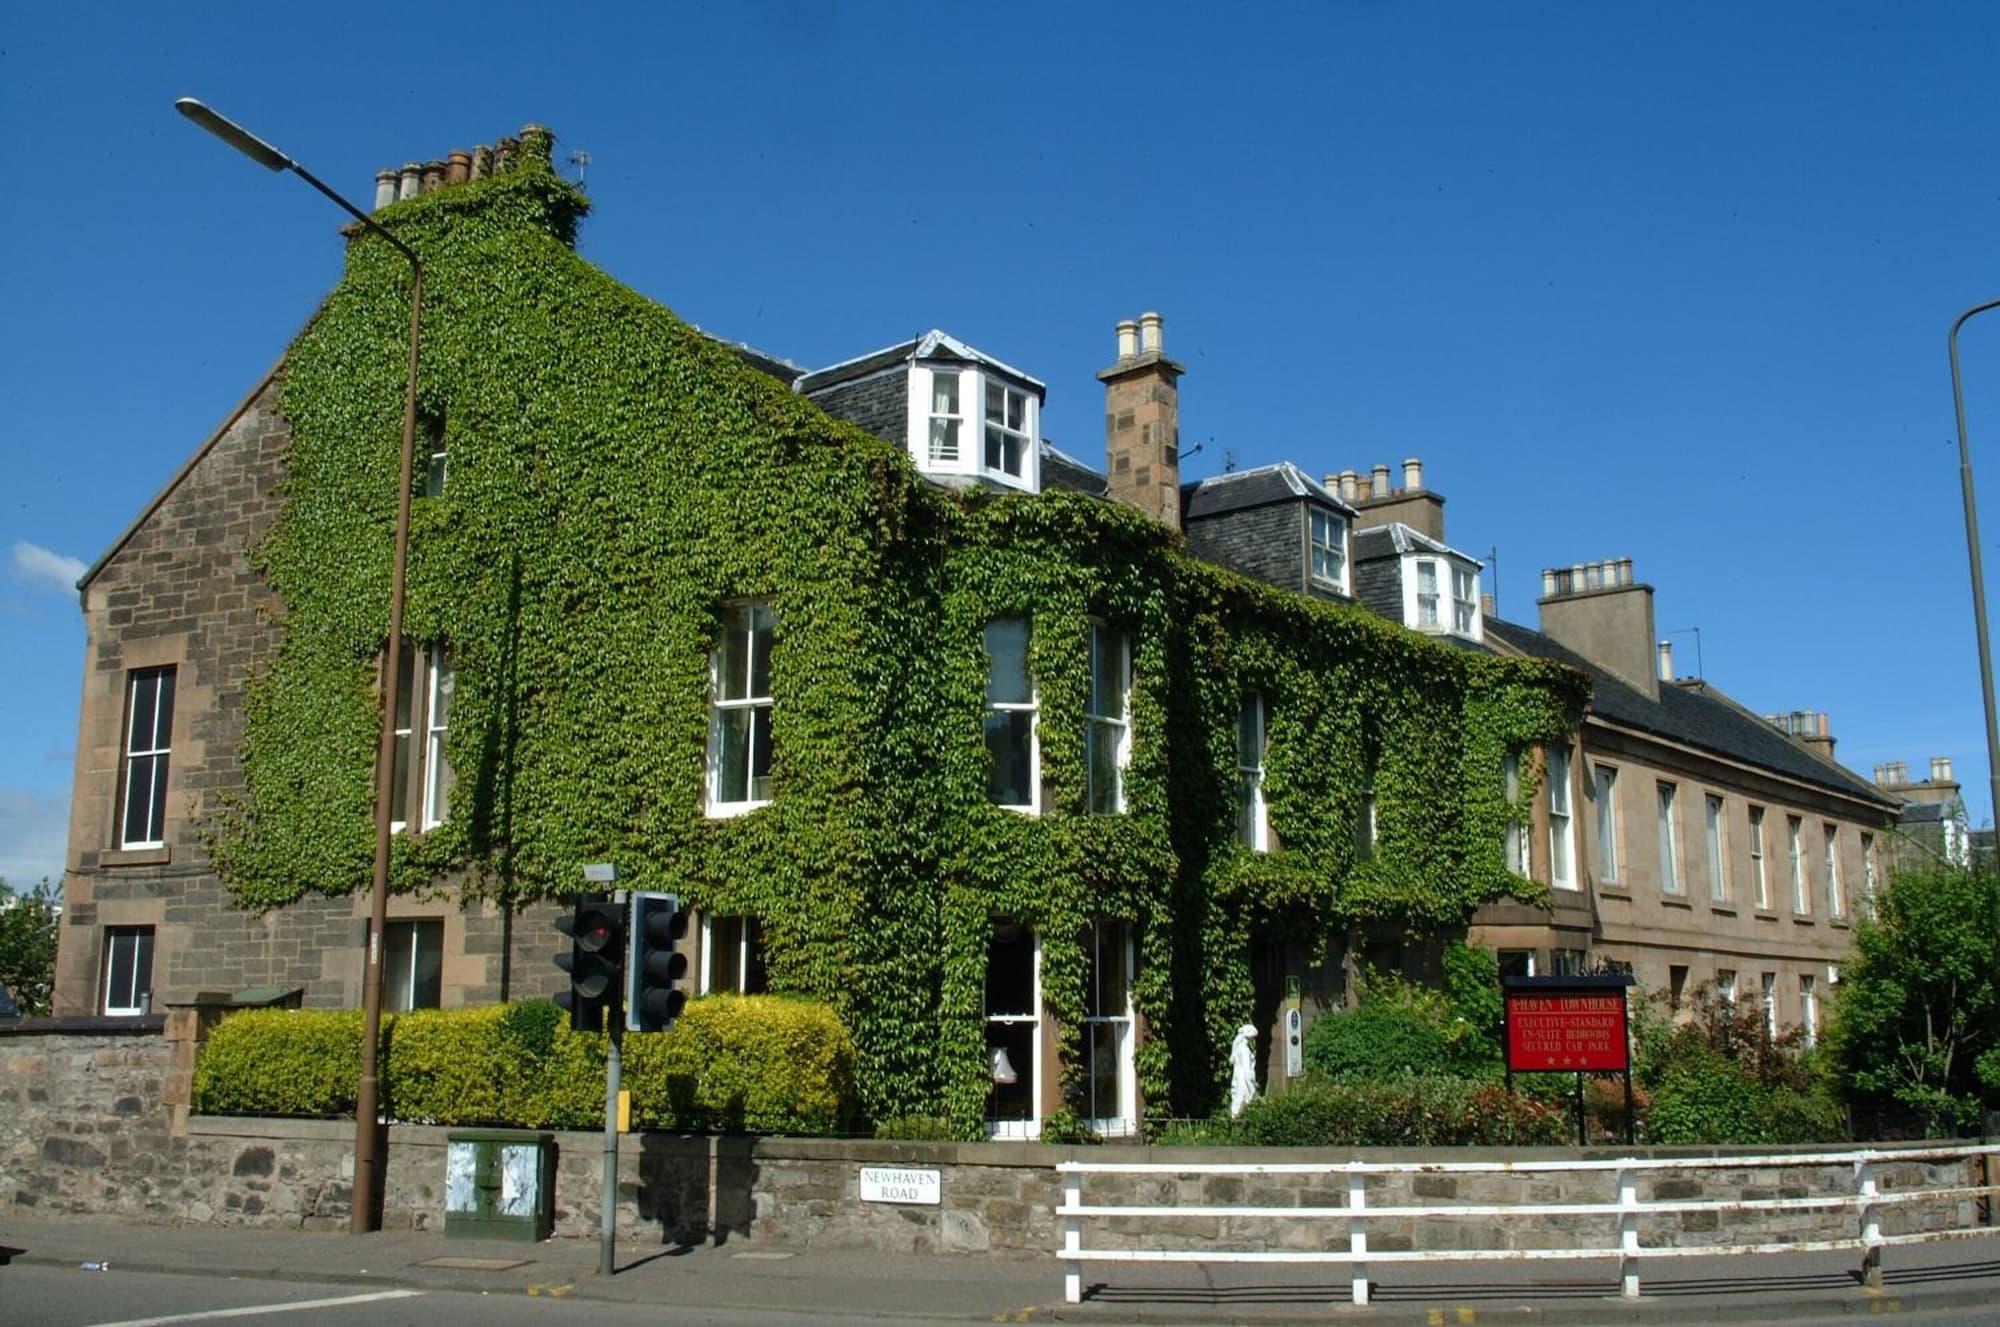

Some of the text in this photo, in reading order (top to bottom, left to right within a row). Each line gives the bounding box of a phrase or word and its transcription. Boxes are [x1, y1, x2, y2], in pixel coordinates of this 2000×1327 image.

[1560, 997, 1618, 1011] TOWNHOUSE
[1521, 1029, 1611, 1040] EN-SUITE BEDROOMS
[1521, 1041, 1610, 1052] SECURED CAR PARK
[864, 1170, 936, 1185] NEWHAVEN
[881, 1186, 918, 1200] ROAD
